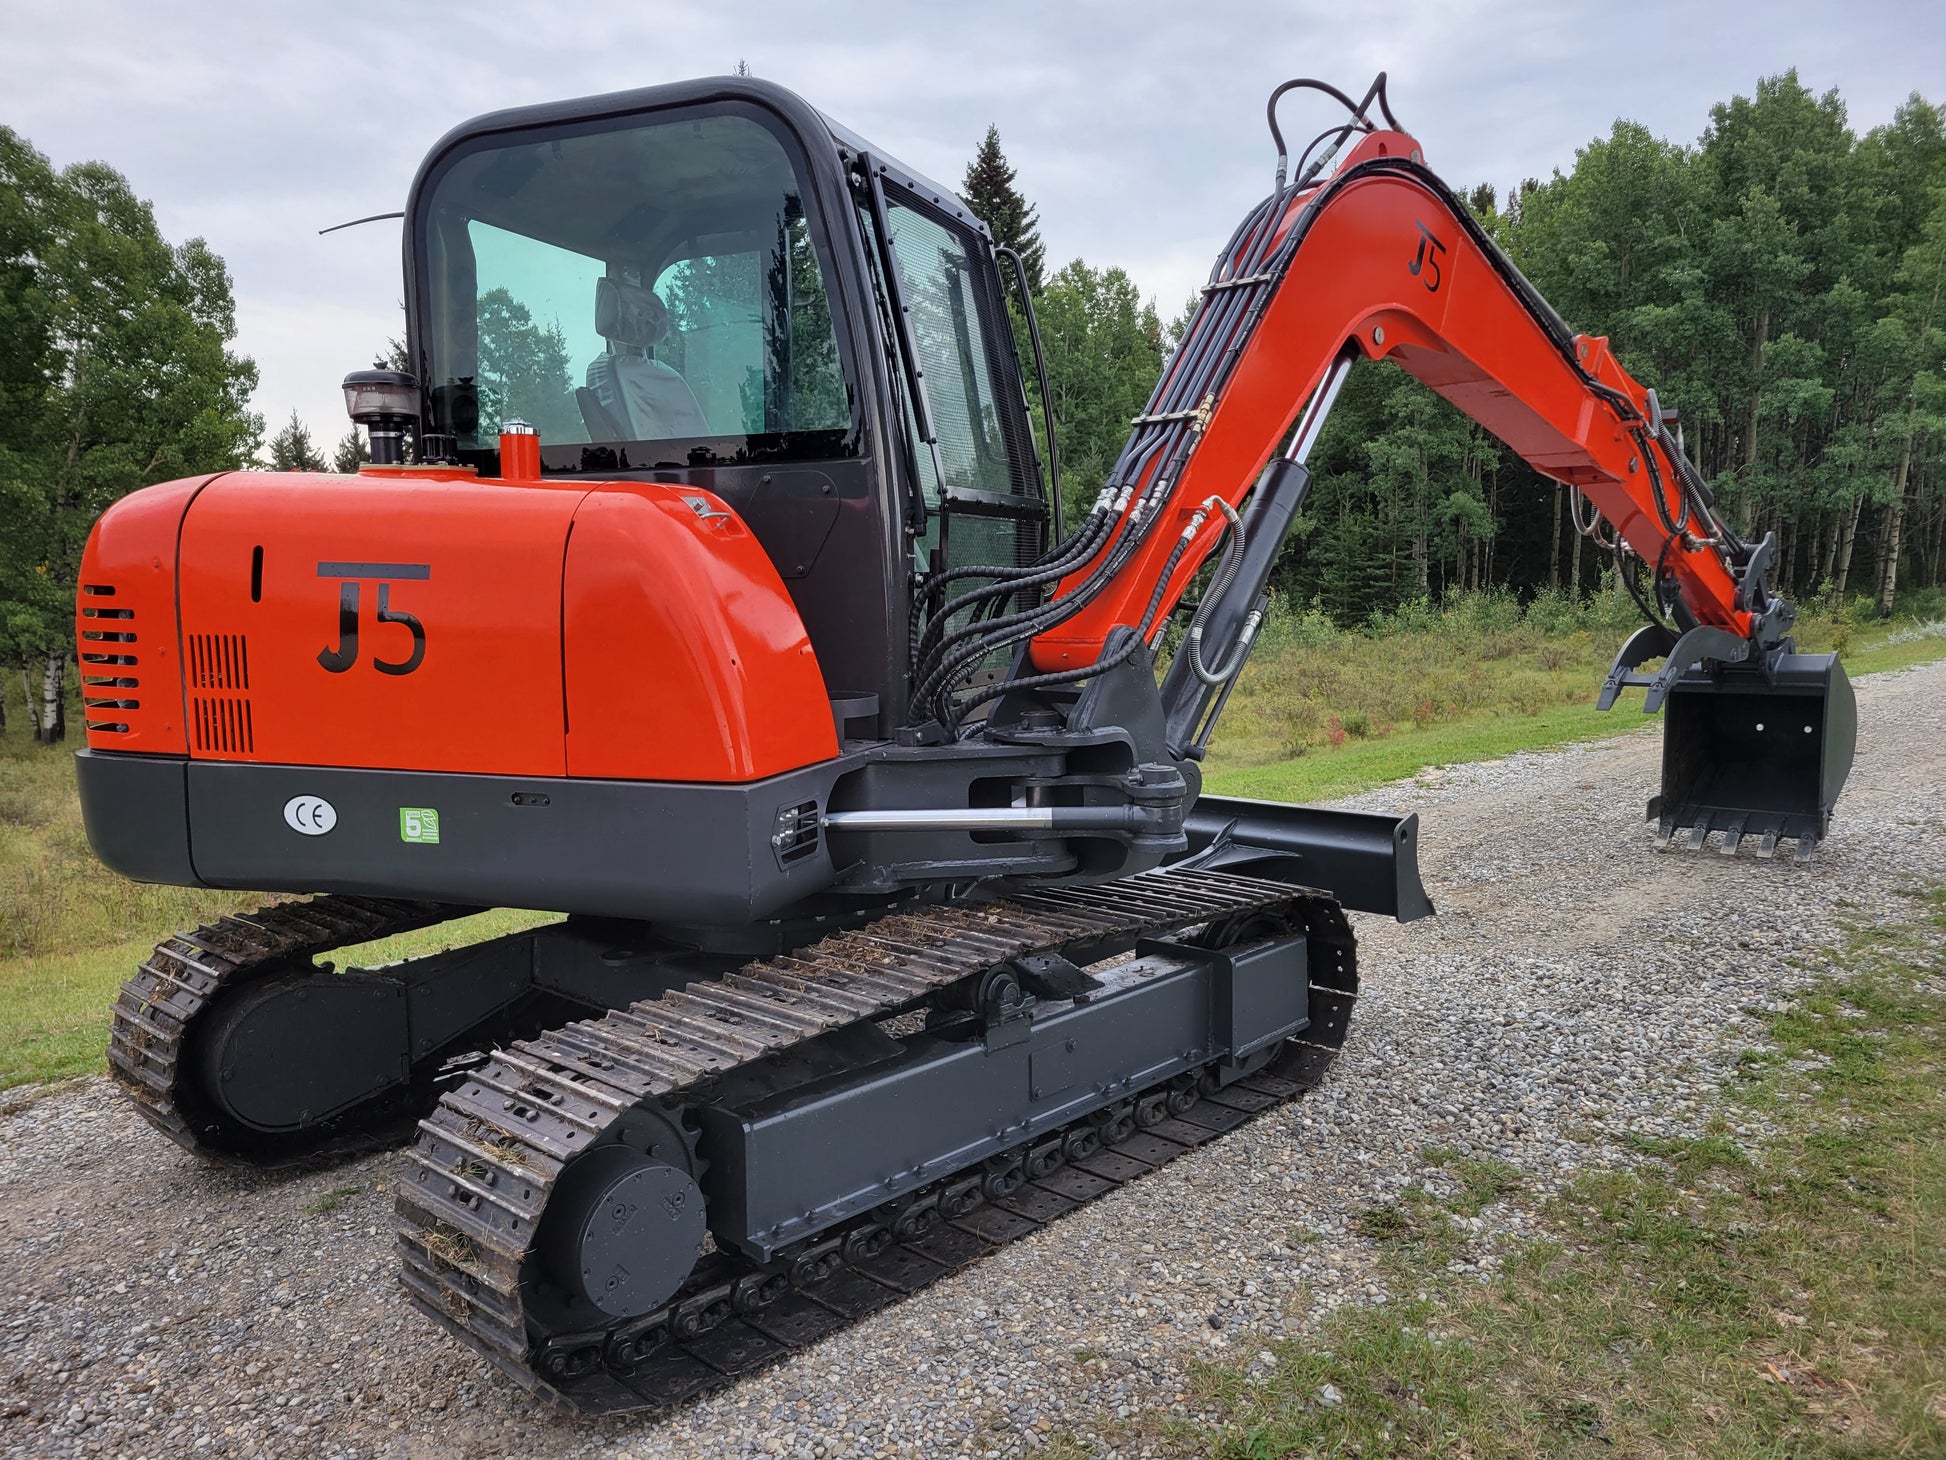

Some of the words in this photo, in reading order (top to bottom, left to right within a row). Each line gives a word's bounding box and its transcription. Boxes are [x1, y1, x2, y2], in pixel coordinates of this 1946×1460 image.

[1408, 218, 1447, 293] J5
[316, 561, 431, 676] J5
[295, 802, 323, 829] CE
[406, 811, 422, 837] 5
